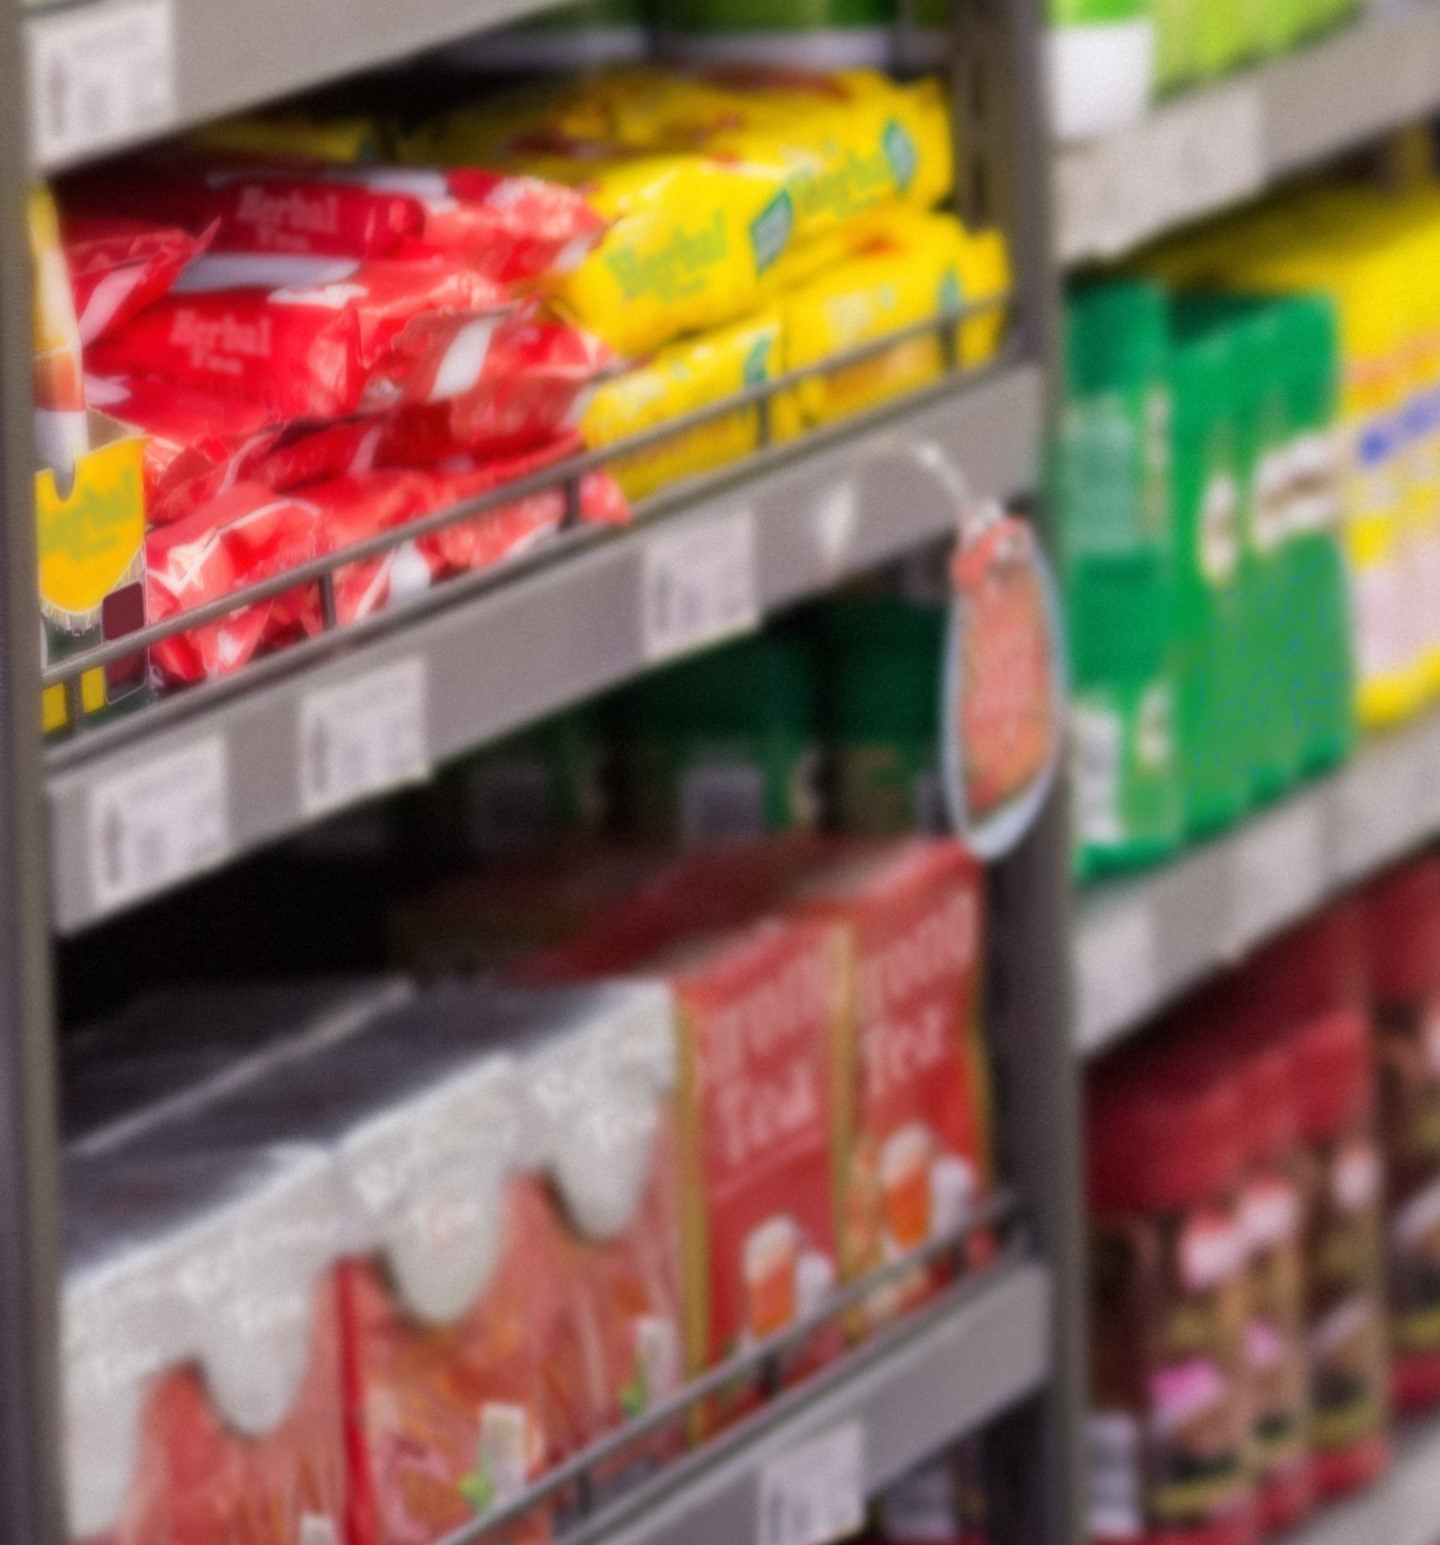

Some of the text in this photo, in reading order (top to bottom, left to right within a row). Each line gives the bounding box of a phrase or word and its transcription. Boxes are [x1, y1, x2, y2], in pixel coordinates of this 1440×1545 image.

[236, 184, 340, 235] Herbal
[606, 207, 726, 302] Herbal
[170, 311, 271, 358] Herbal
